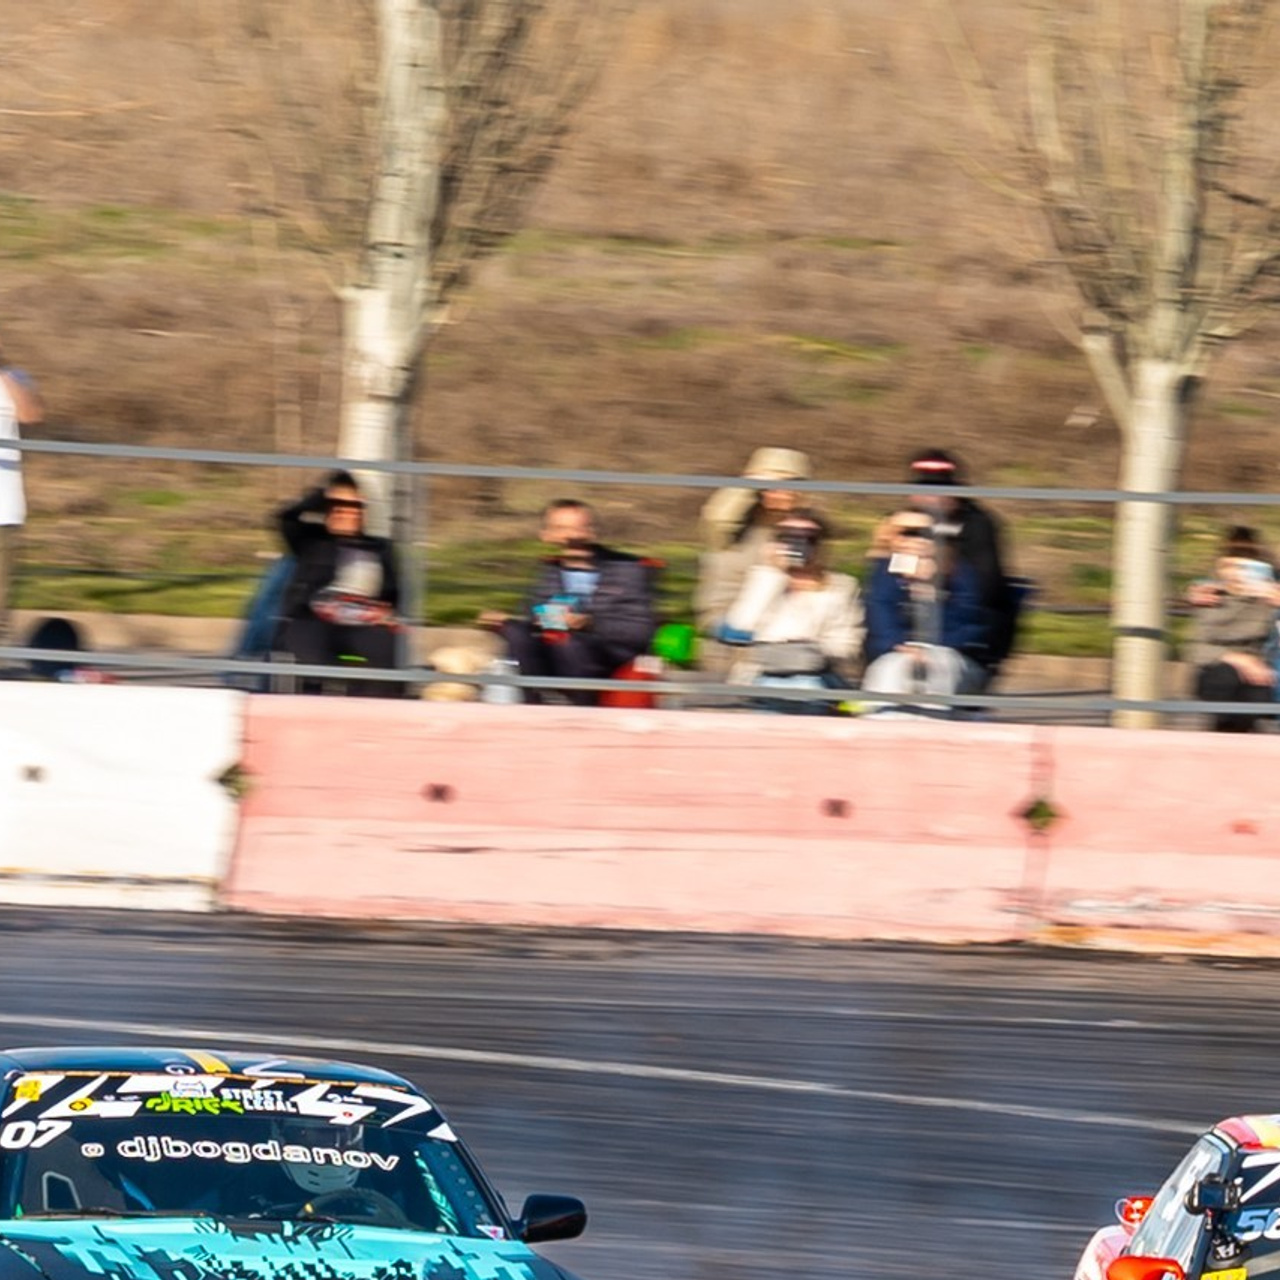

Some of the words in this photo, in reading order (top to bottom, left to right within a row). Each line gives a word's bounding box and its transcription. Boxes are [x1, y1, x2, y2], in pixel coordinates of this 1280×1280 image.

[220, 1088, 284, 1103] STREET
[242, 1097, 298, 1113] LEGAL
[0, 1120, 73, 1149] 07
[117, 1136, 401, 1172] djbogdanov
